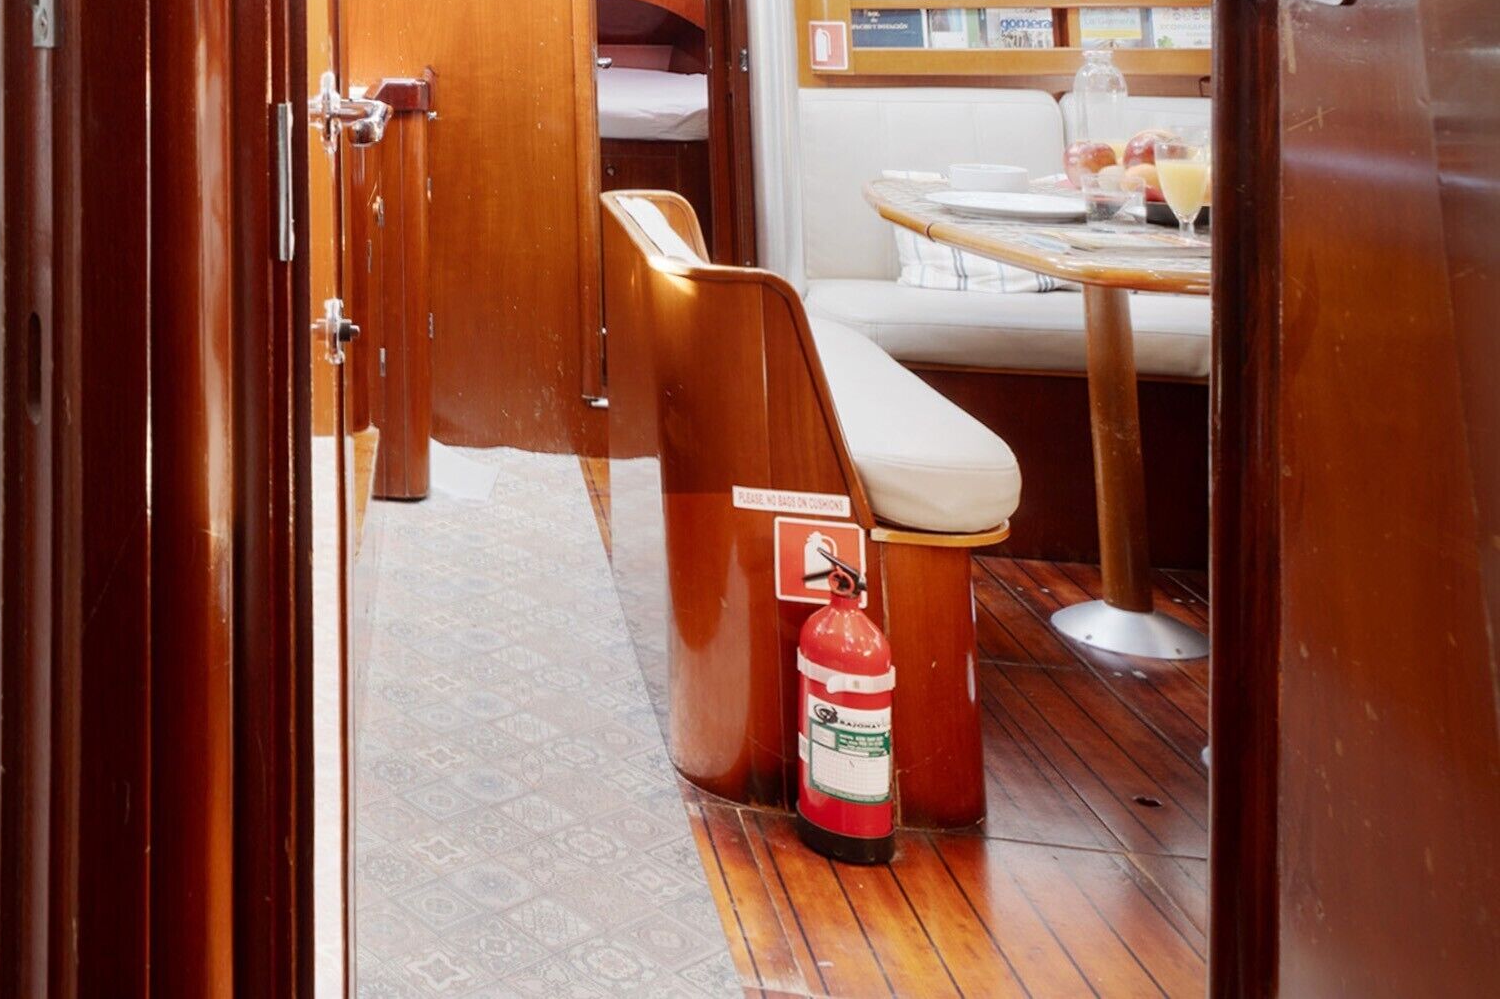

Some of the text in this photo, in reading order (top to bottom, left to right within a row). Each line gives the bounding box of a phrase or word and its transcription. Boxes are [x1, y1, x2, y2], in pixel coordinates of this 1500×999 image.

[1000, 18, 1053, 31] gomera
[766, 493, 776, 506] NO
[777, 494, 796, 508] BAGS
[797, 496, 807, 508] ON
[809, 497, 844, 512] CUSHIONS
